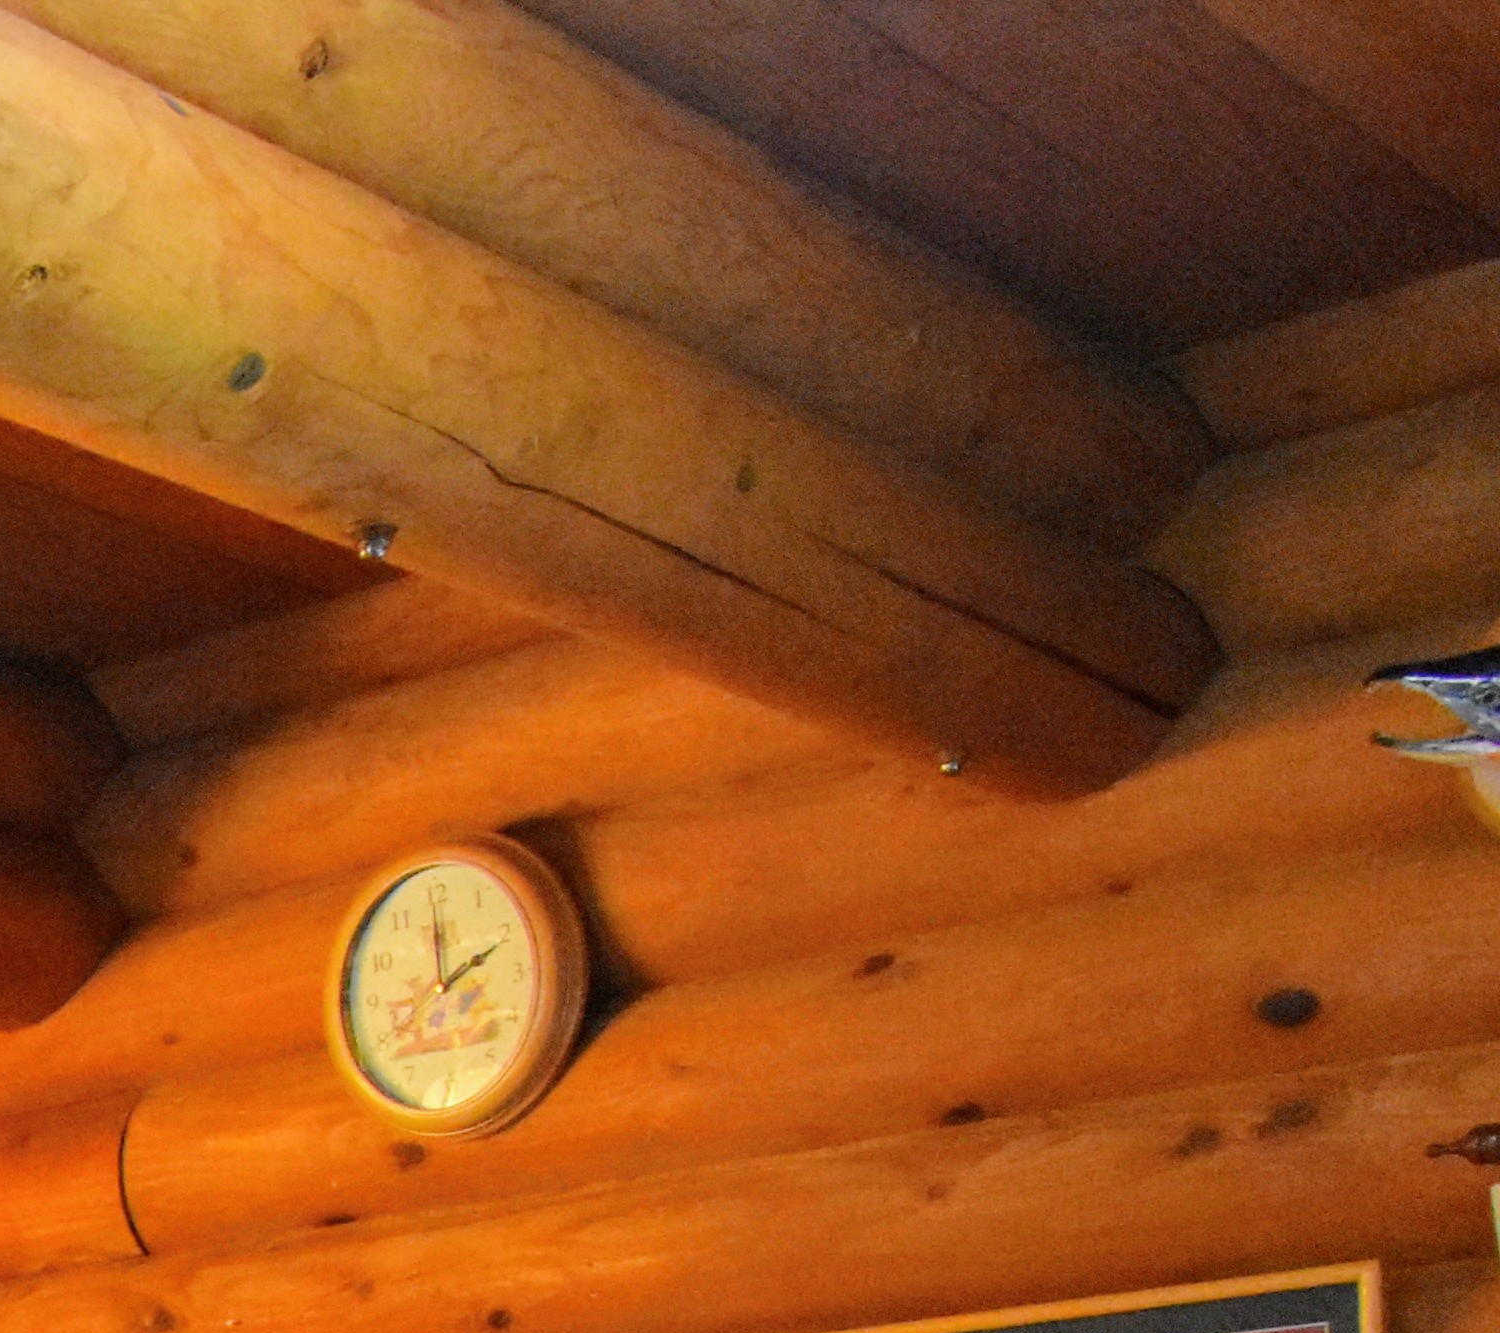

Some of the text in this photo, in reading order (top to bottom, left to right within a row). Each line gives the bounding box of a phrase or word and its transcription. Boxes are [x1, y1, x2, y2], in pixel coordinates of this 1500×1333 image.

[429, 884, 447, 904] 12
[475, 889, 482, 908] 1
[392, 910, 410, 930] 11
[499, 923, 511, 943] 2
[373, 952, 392, 973] 10
[513, 962, 524, 983] 3
[367, 993, 379, 1009] 9
[404, 1065, 415, 1082] 7
